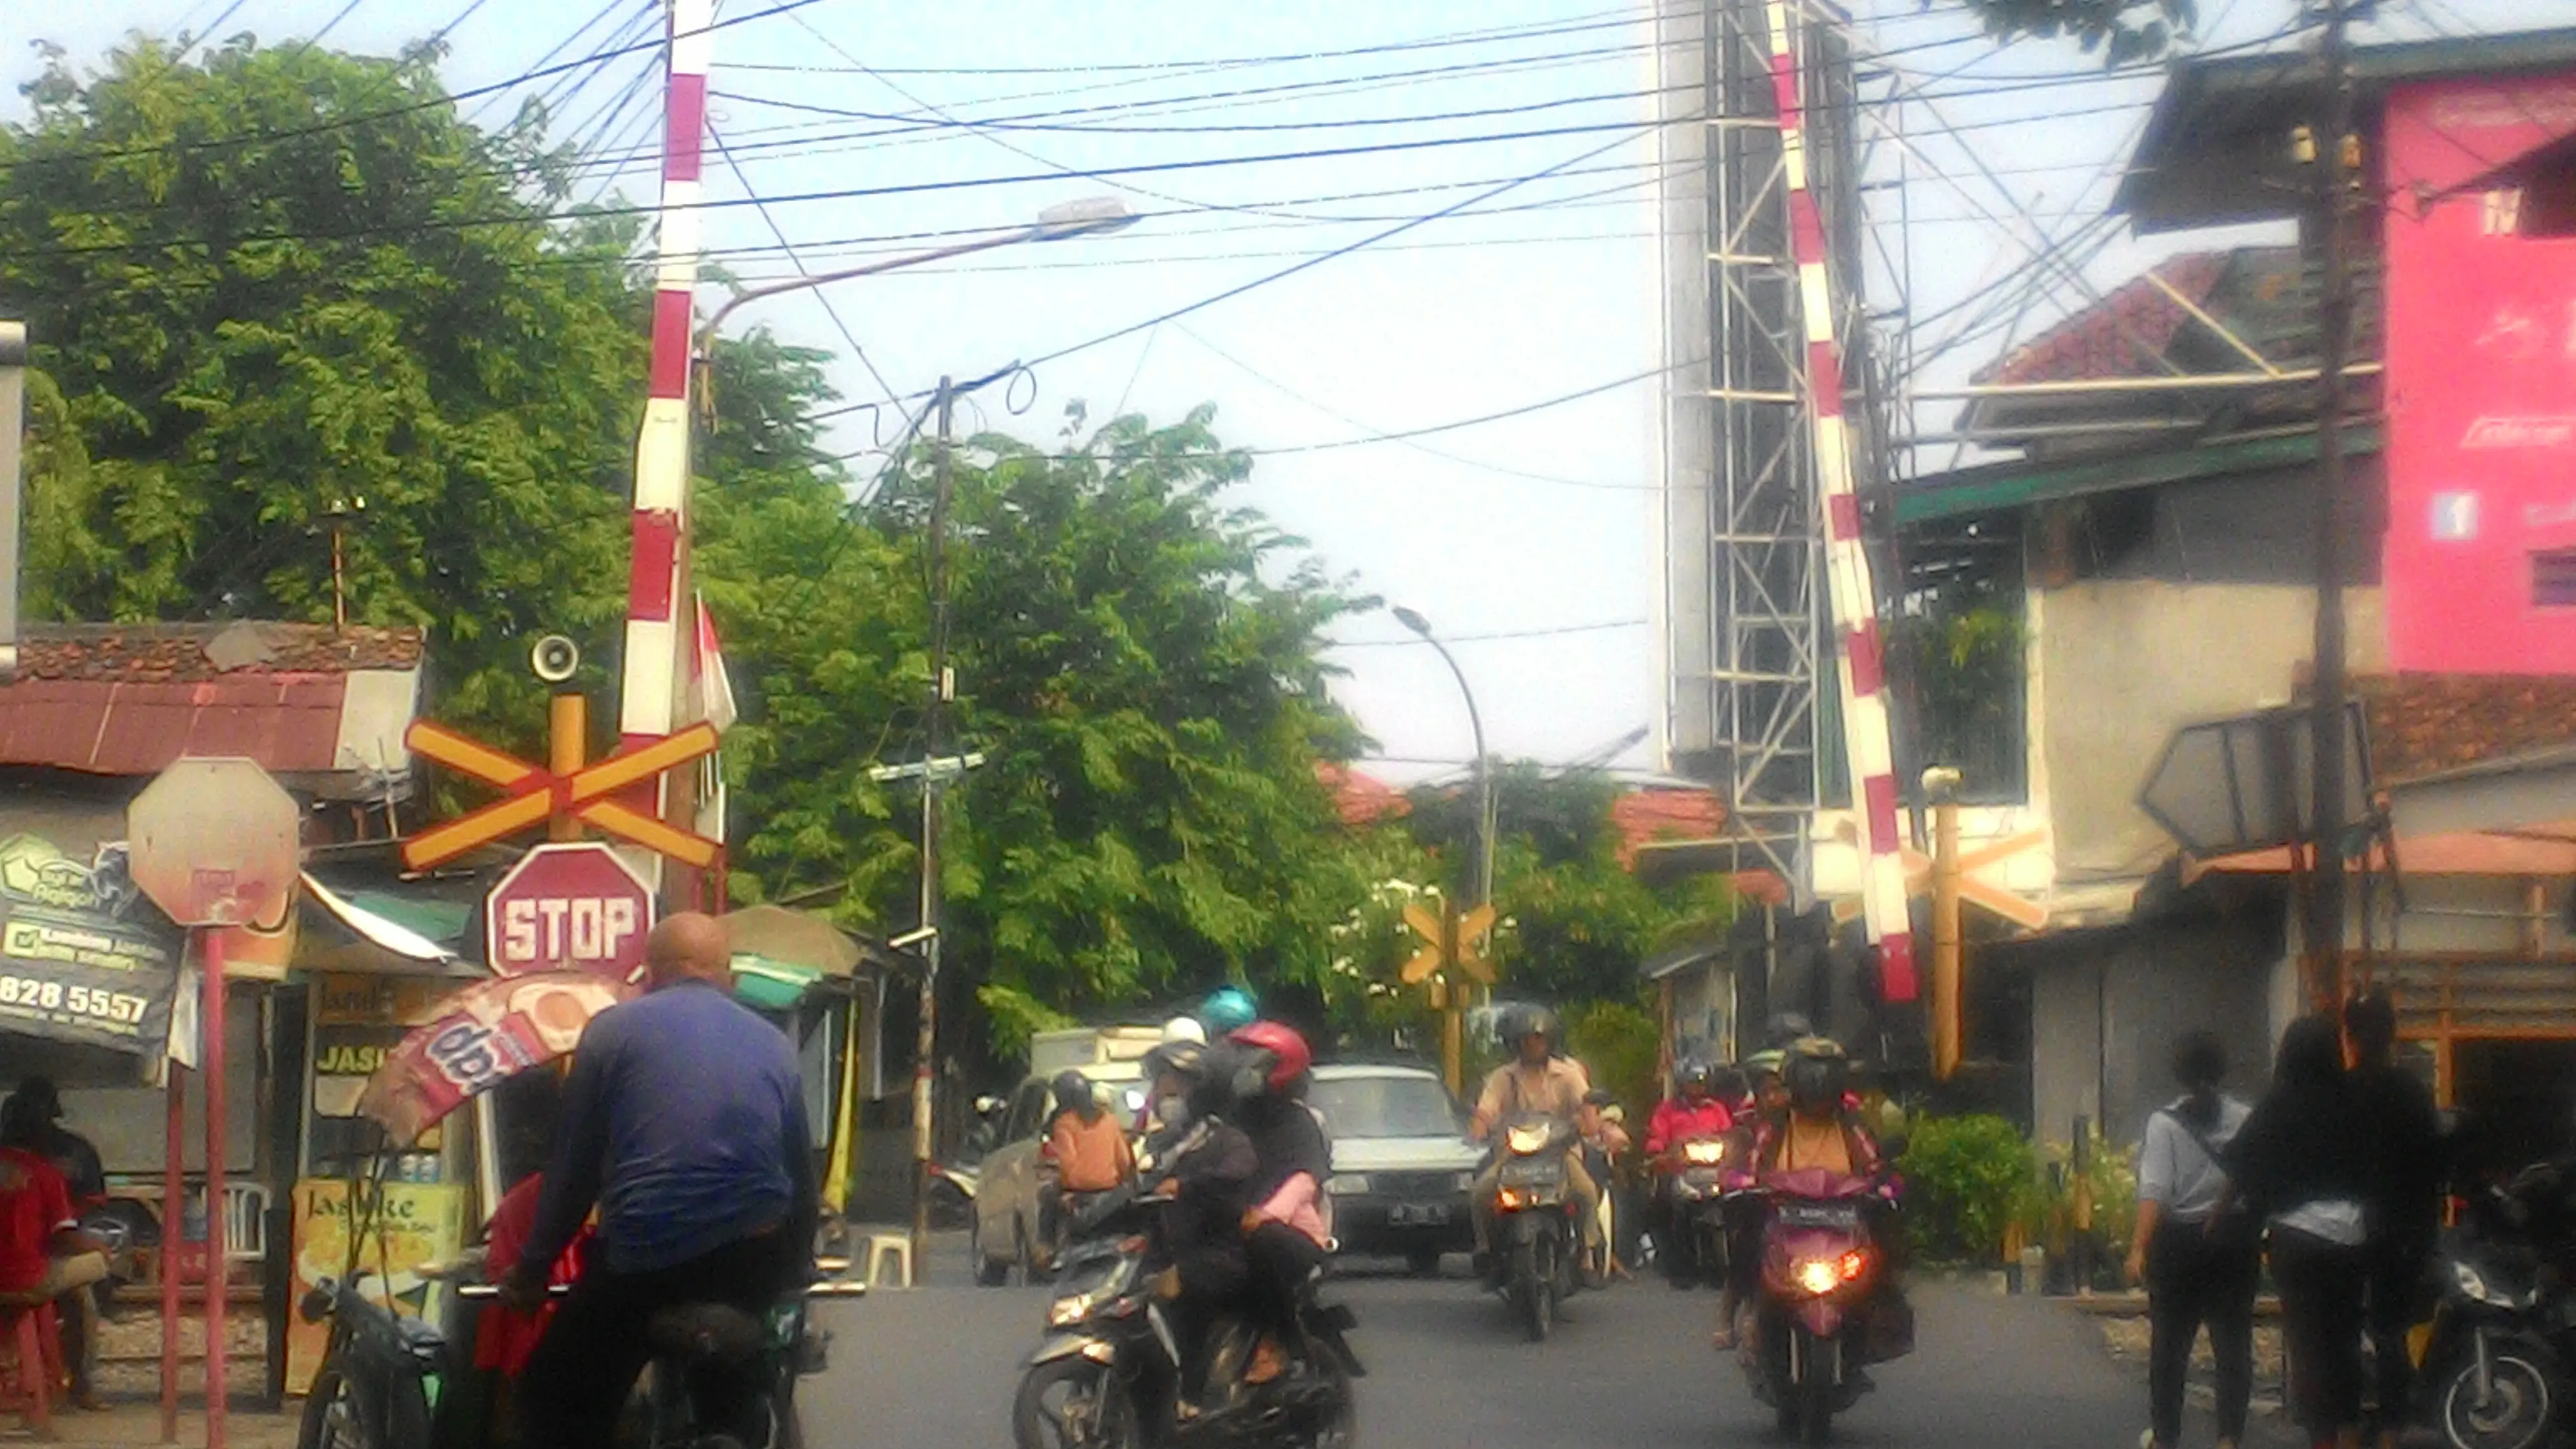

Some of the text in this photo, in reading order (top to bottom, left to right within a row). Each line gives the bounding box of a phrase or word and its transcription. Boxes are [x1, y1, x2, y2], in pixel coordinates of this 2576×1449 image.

[505, 898, 635, 960] STOP
[0, 976, 62, 1009] 828
[67, 985, 148, 1024] 5557
